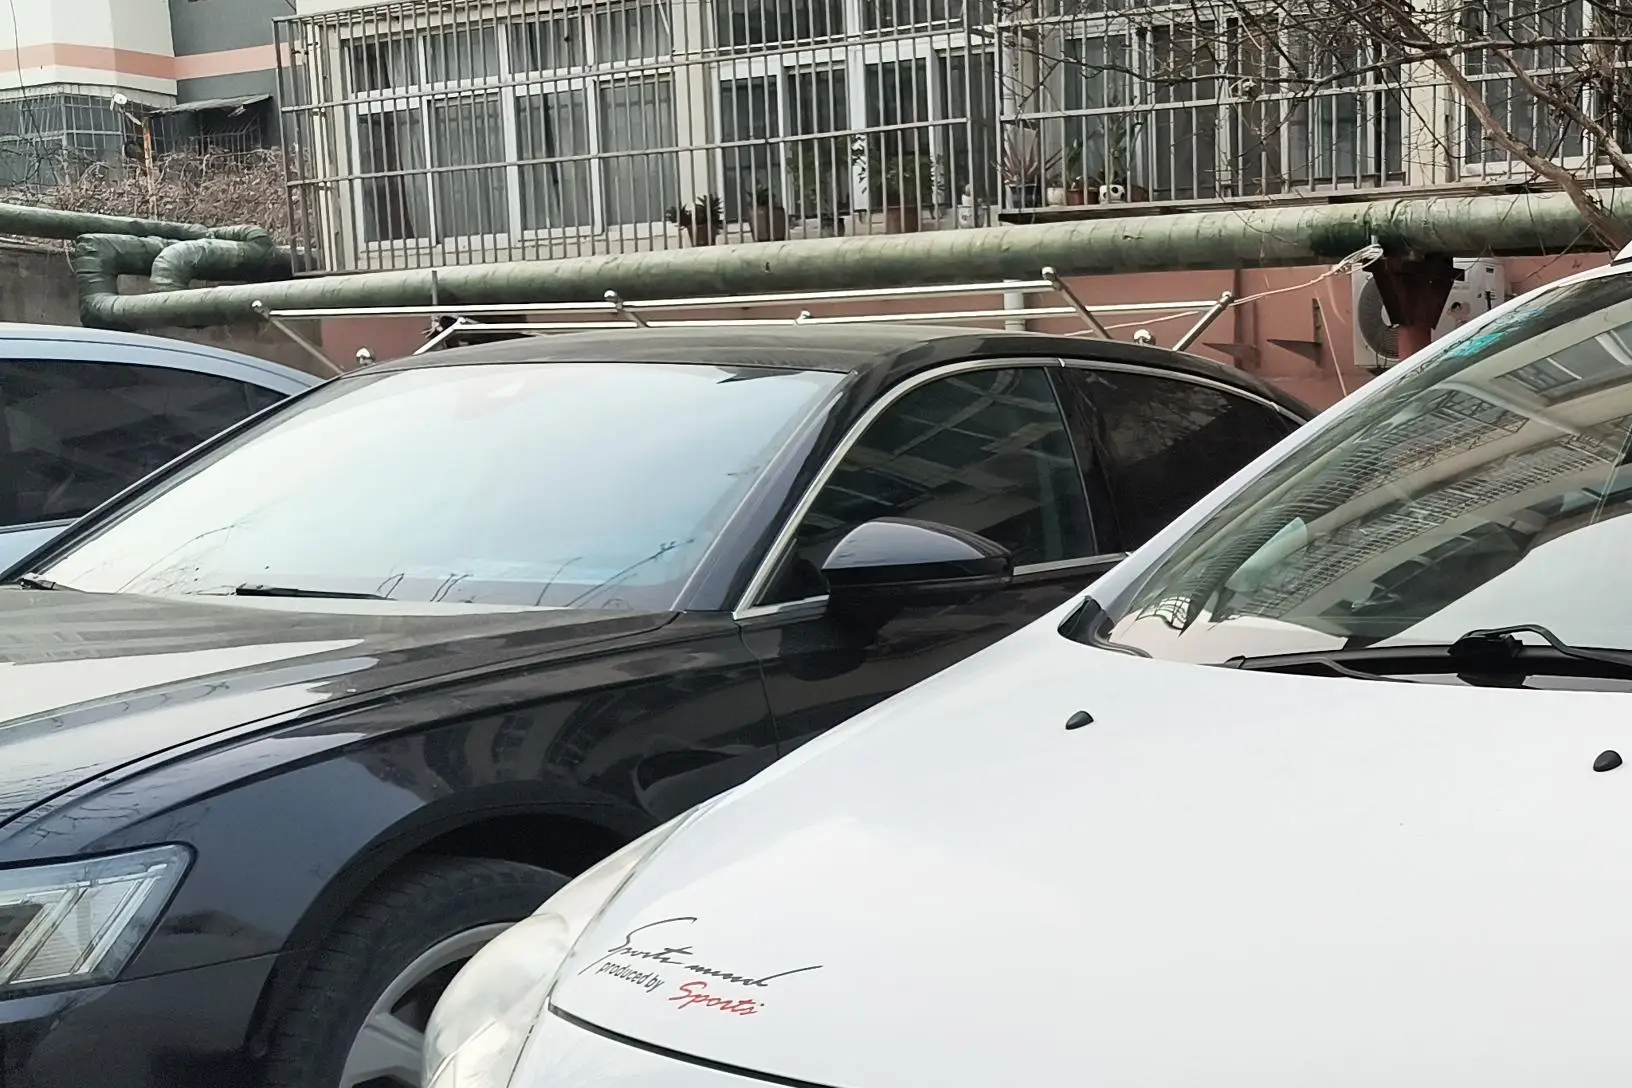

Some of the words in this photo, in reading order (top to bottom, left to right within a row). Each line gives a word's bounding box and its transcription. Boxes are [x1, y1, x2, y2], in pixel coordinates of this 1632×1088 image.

[595, 962, 654, 985] produced
[643, 973, 665, 993] by
[669, 982, 757, 1015] Sports
